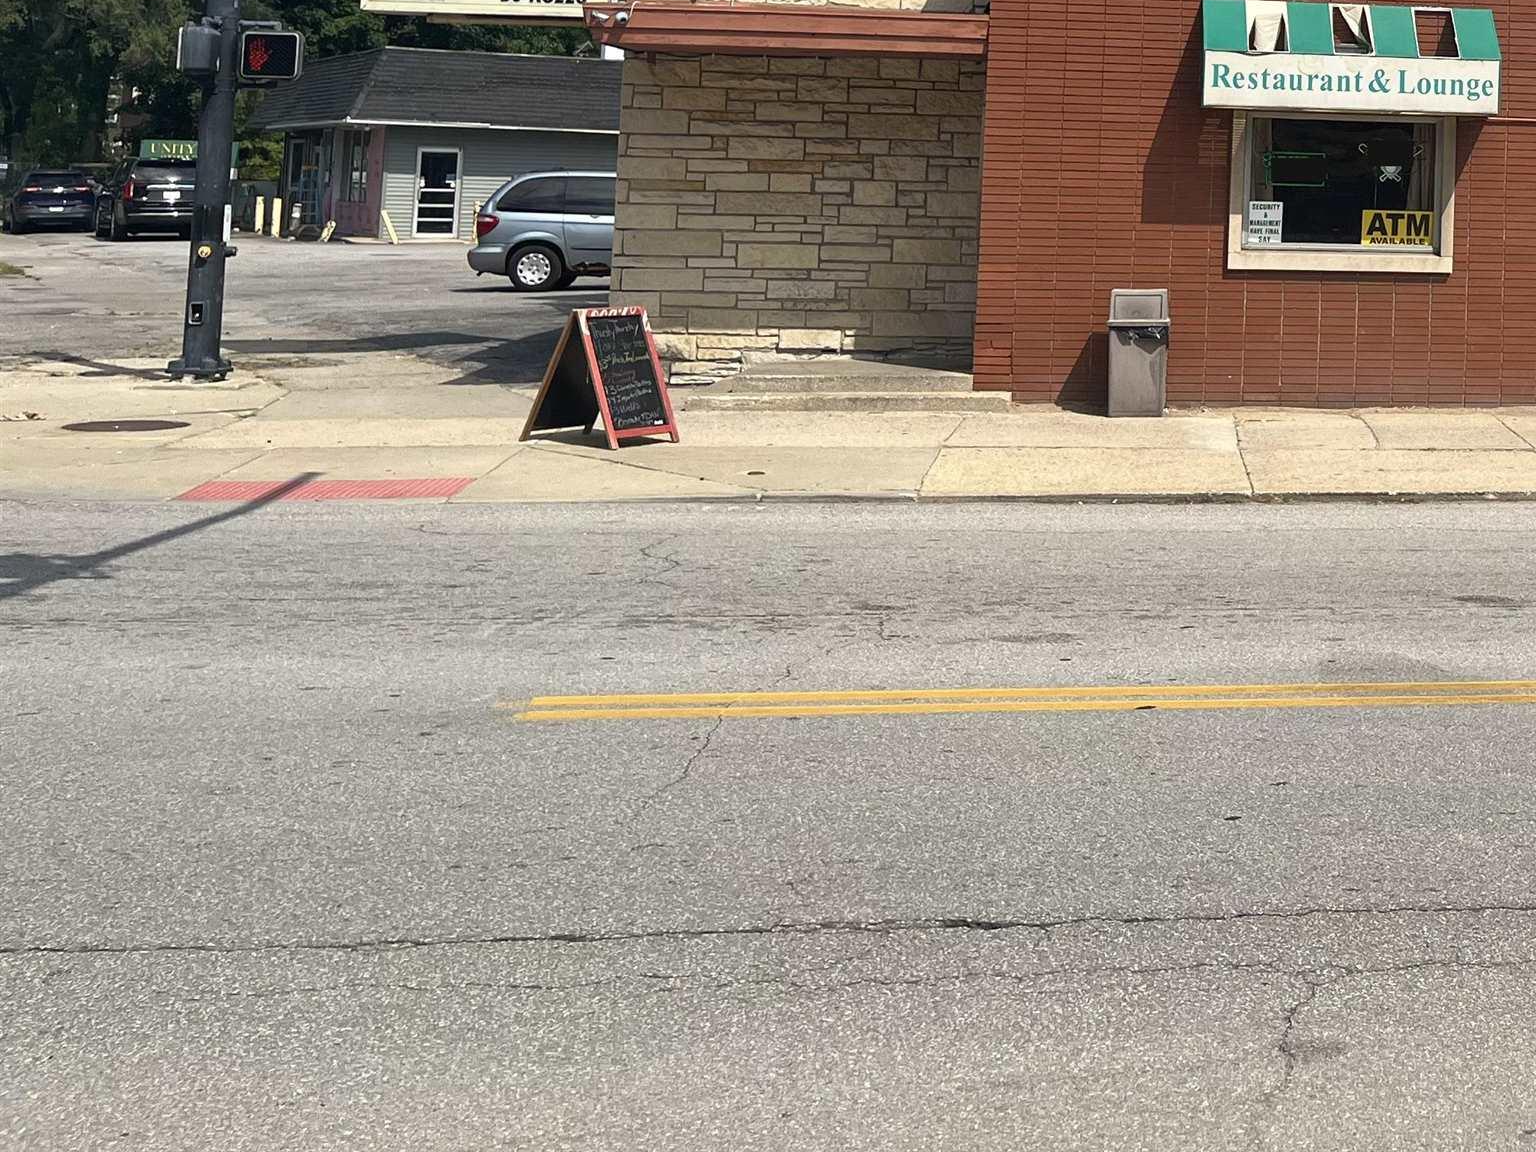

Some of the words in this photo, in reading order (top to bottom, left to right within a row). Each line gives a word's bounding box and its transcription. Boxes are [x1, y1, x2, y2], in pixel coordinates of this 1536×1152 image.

[1211, 63, 1362, 93] Restaurant
[1368, 68, 1391, 94] &
[1398, 69, 1494, 102] Lounge
[151, 143, 194, 154] UNITY
[1366, 212, 1430, 237] ATM
[1369, 237, 1426, 245] AVAILABLE
